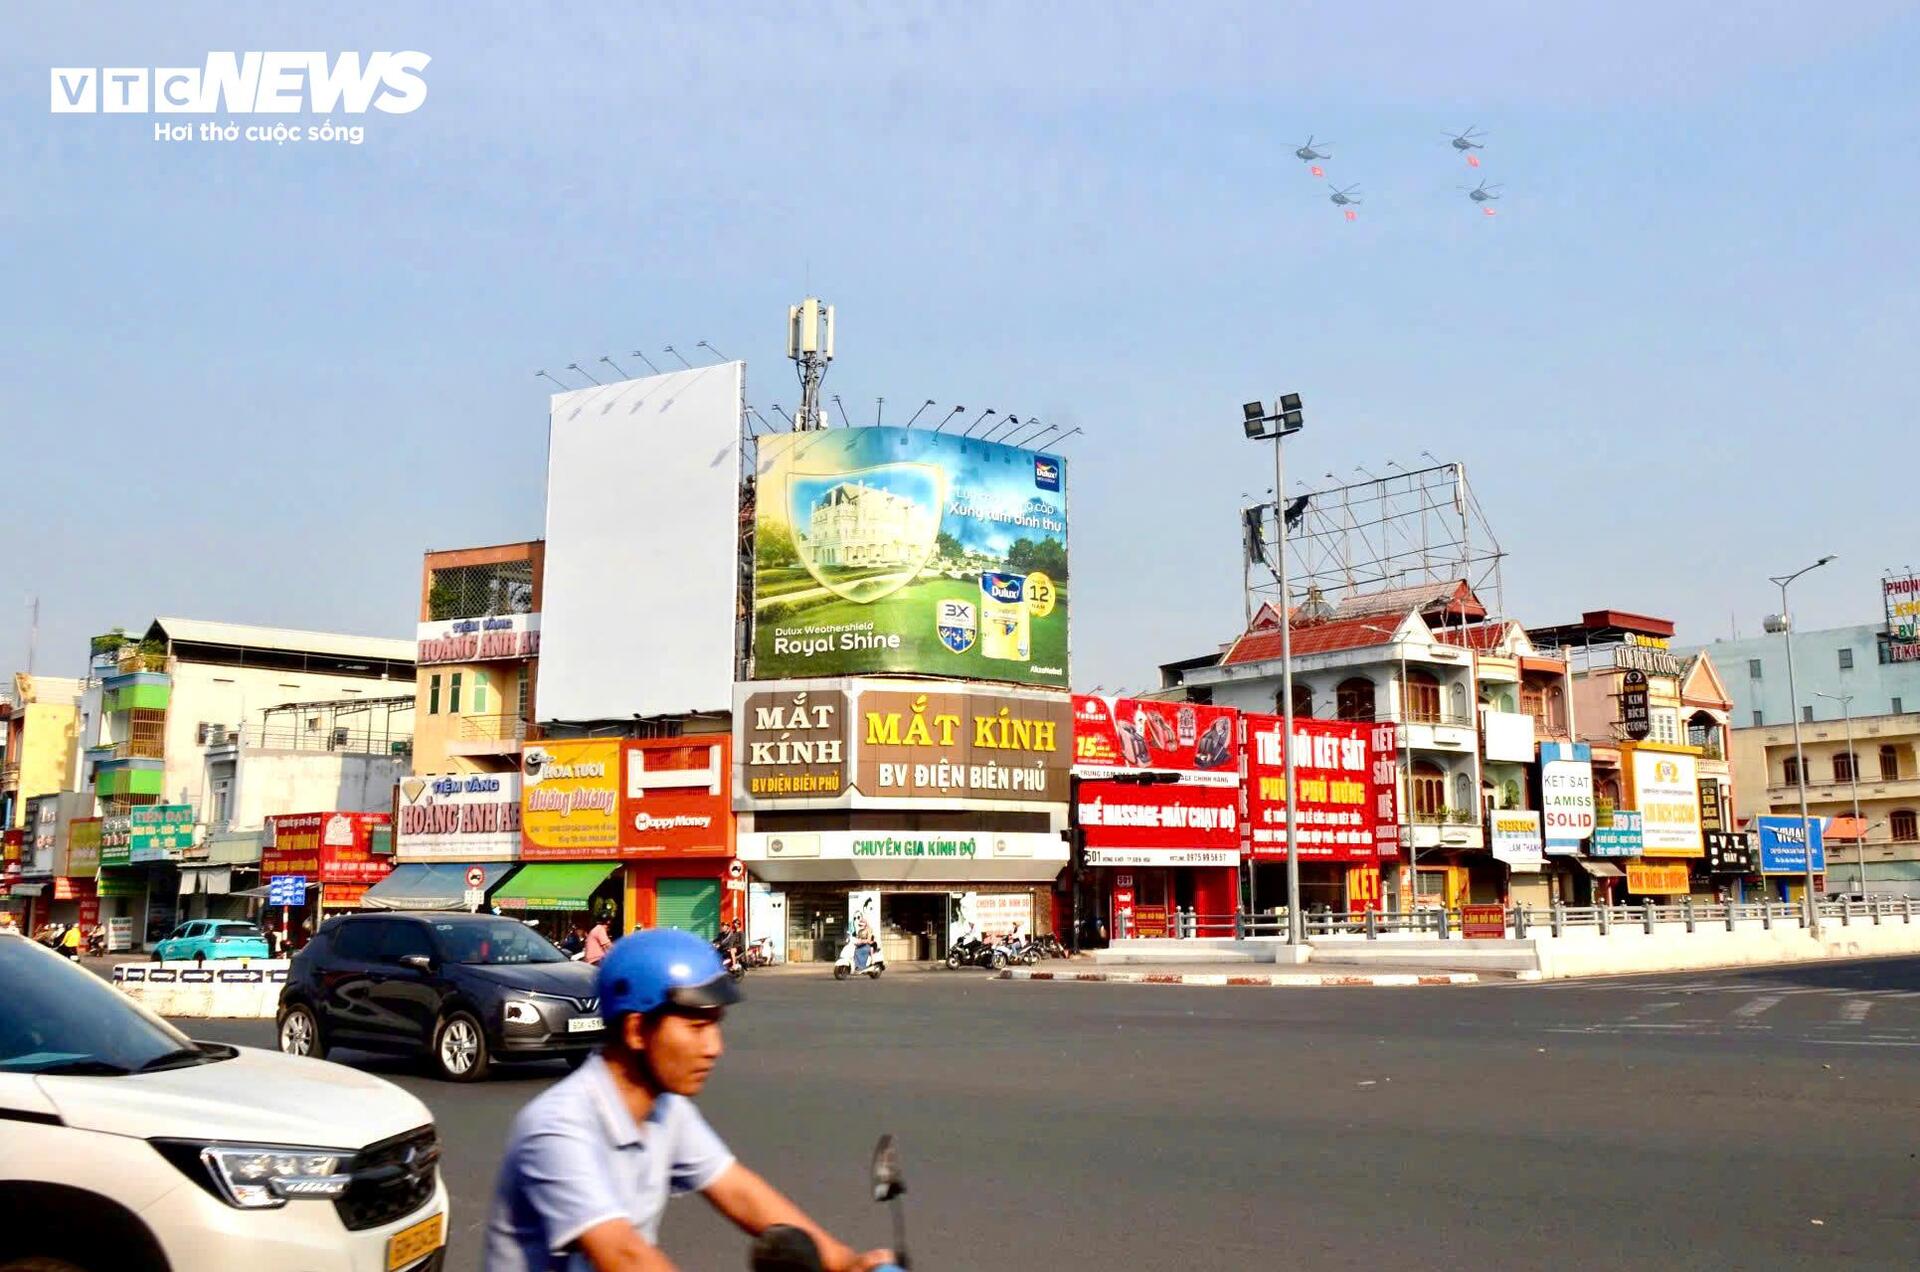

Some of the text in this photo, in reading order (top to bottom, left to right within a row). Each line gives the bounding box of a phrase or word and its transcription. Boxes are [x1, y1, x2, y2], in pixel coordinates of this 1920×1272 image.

[1036, 468, 1058, 479] Dulux
[991, 584, 1019, 599] Dulux
[1030, 585, 1049, 603] 12
[945, 604, 969, 618] 3X
[775, 620, 874, 637] Dulux Weathershield
[480, 632, 517, 658] ANH
[774, 631, 900, 656] Royal Shine
[1628, 694, 1643, 705] KIM
[755, 692, 834, 730] MẮT
[865, 694, 961, 747] MẮT
[973, 706, 1057, 752] KÍNH
[750, 732, 842, 765] KÍNH
[1077, 735, 1097, 757] 15
[543, 763, 573, 779] HOA
[879, 757, 1045, 793] BV ĐIỆN BIÊN PHỦ
[1544, 775, 1590, 788] KET SAT
[432, 777, 499, 797] TIỆM VÀNG
[752, 770, 840, 795] BV ĐIỆN BIÊN PHỦ
[1545, 796, 1592, 807] LAMISS
[460, 802, 499, 834] ANH
[1546, 813, 1592, 827] SOLID
[852, 836, 977, 860] CHUYÊN GIA KÍNH ĐỘ
[1350, 863, 1380, 900] KÉT
